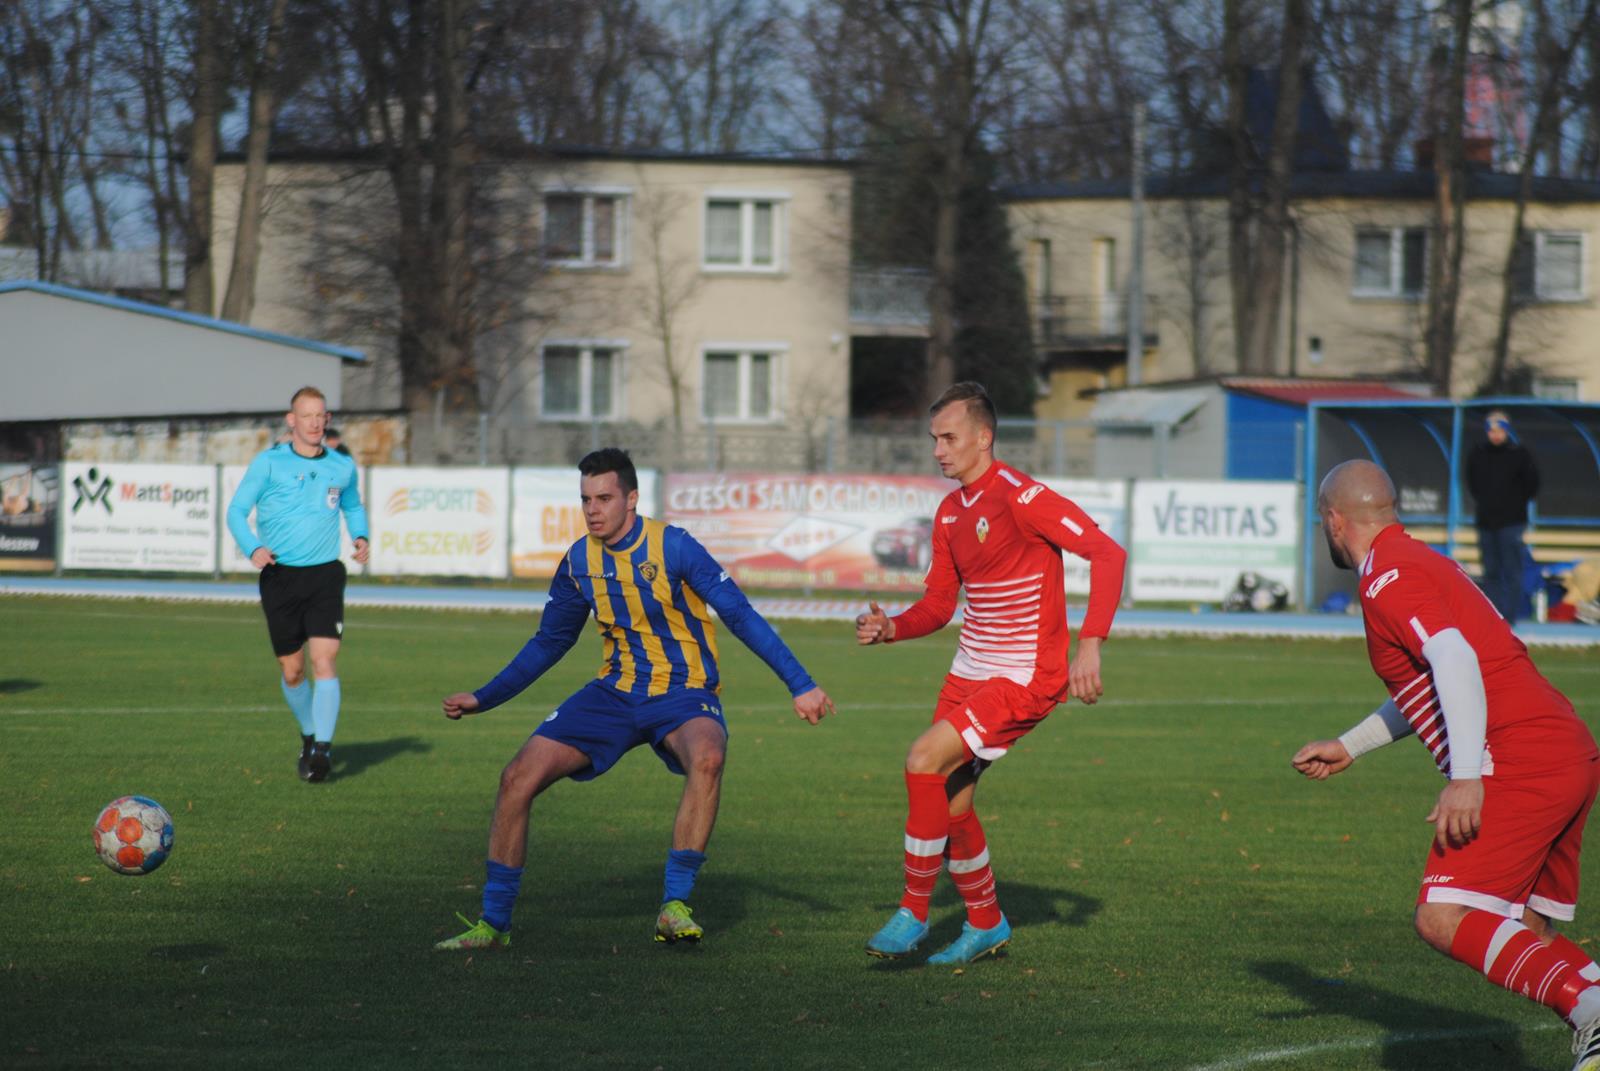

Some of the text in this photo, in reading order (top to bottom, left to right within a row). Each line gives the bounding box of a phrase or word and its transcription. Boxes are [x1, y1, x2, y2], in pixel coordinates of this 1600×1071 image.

[121, 482, 209, 508] MattSport
[408, 488, 476, 512] SPORT
[1153, 490, 1279, 538] VERITAS
[380, 531, 475, 556] PLESZEW
